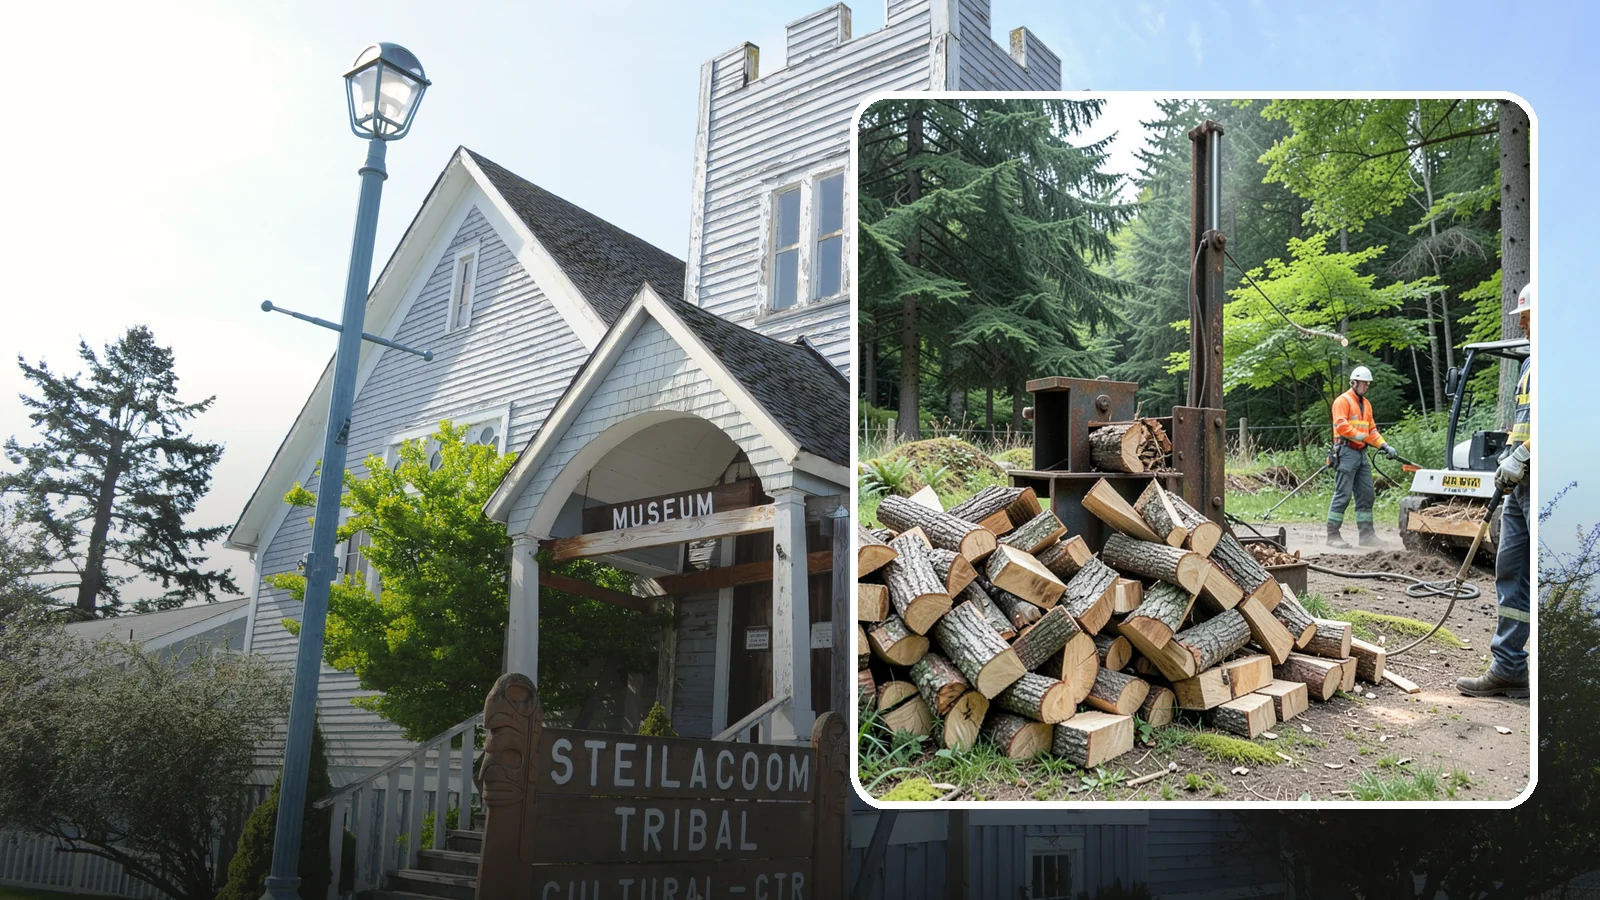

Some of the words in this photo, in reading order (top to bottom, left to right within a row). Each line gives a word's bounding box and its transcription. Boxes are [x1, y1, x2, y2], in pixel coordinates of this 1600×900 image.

[613, 492, 713, 531] MUSEUM
[551, 738, 811, 793] STEILACOOM
[615, 807, 758, 852] TRIBAL
